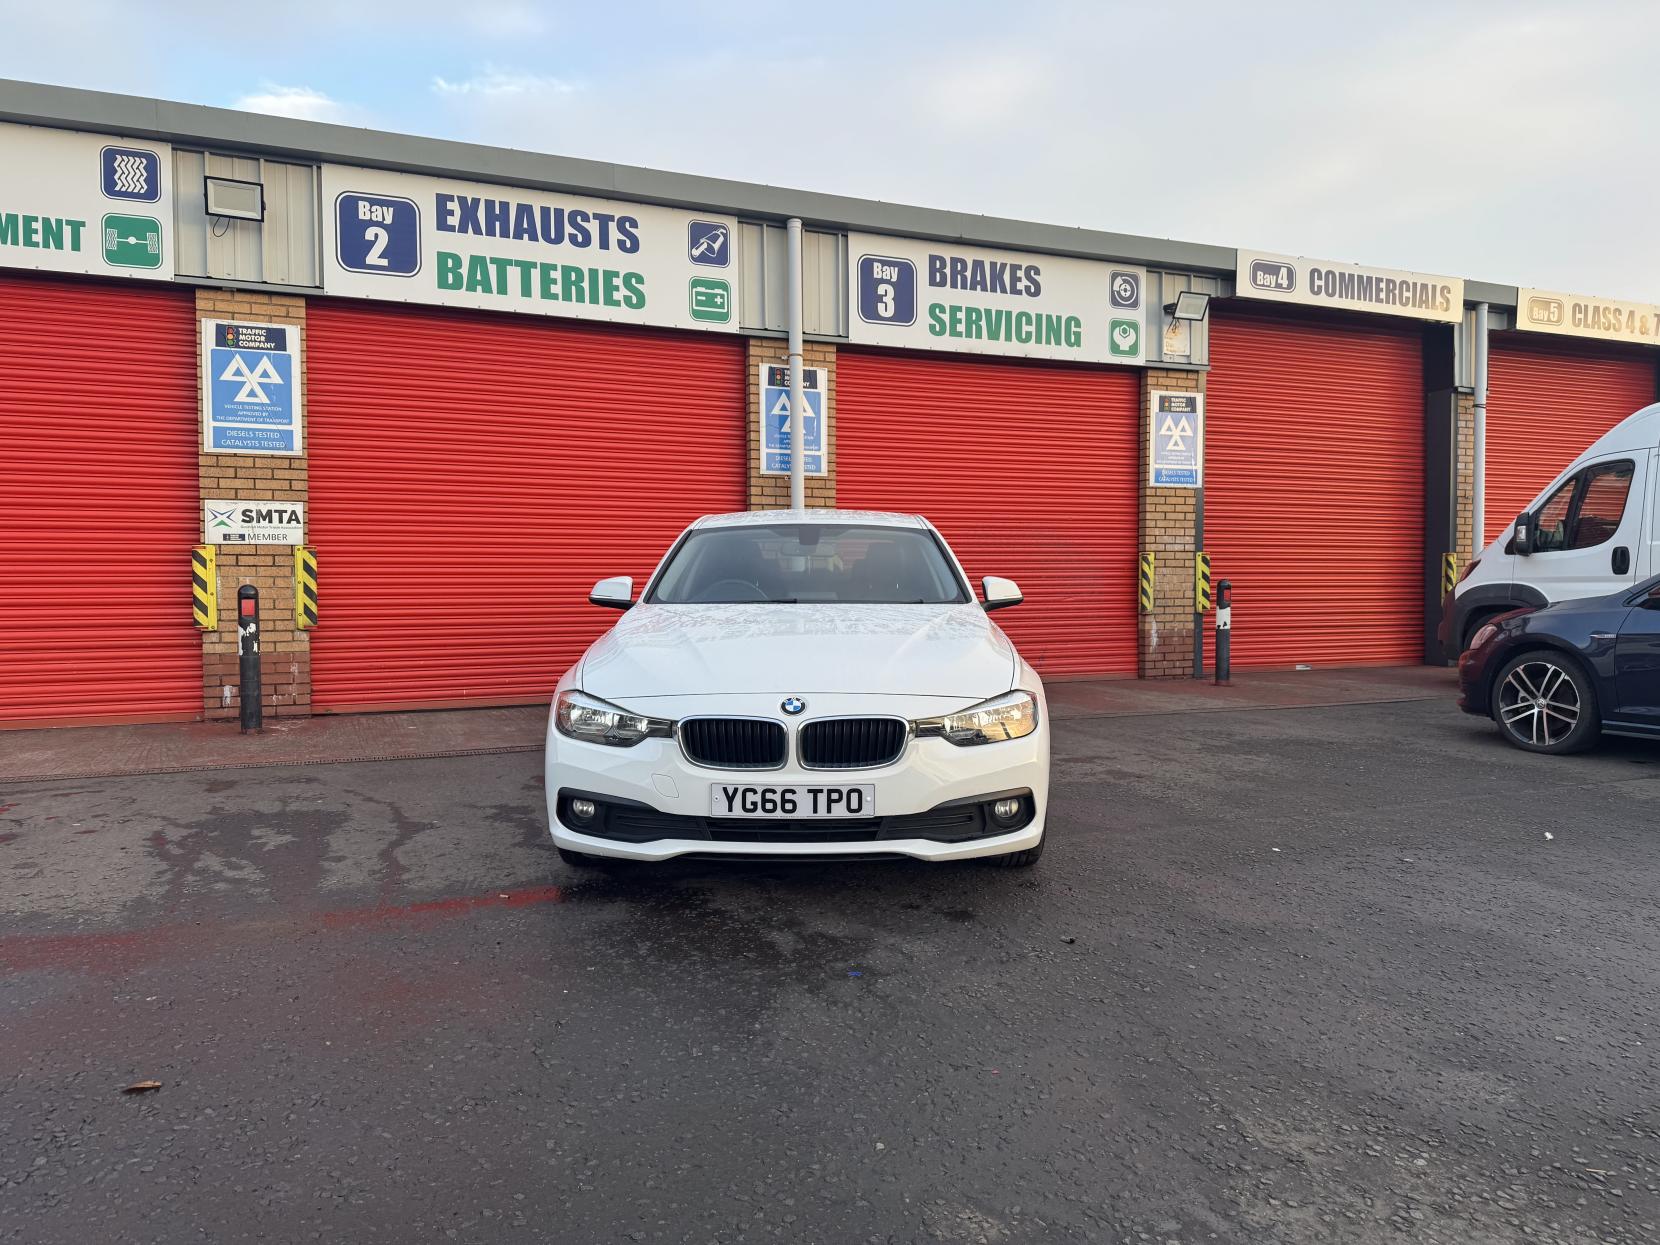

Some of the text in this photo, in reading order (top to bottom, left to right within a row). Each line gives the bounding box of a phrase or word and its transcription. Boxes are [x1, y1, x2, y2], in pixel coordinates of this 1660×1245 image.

[358, 200, 394, 225] Bay
[435, 192, 640, 255] EXHAUSTS
[364, 226, 389, 266] 2
[436, 250, 646, 310] BATTERIES
[873, 262, 898, 282] Bay
[928, 254, 1042, 298] BRAKES
[1256, 266, 1289, 288] Bay 4
[877, 283, 895, 318] 3
[1309, 267, 1451, 312] COMMERCIALS
[1532, 302, 1559, 321] Bay 5
[1571, 302, 1623, 332] CLASS
[1625, 309, 1636, 334] 4
[1639, 314, 1650, 336] &
[928, 302, 1082, 348] SERVICING
[239, 334, 265, 342] MOTOR
[239, 341, 275, 349] COMPANY
[221, 439, 285, 448] CATALYSTS TESTED
[226, 430, 253, 438] DIESELS
[241, 508, 302, 525] SMTA
[248, 533, 288, 541] MEMBER
[722, 786, 863, 814] YG66 TPO
